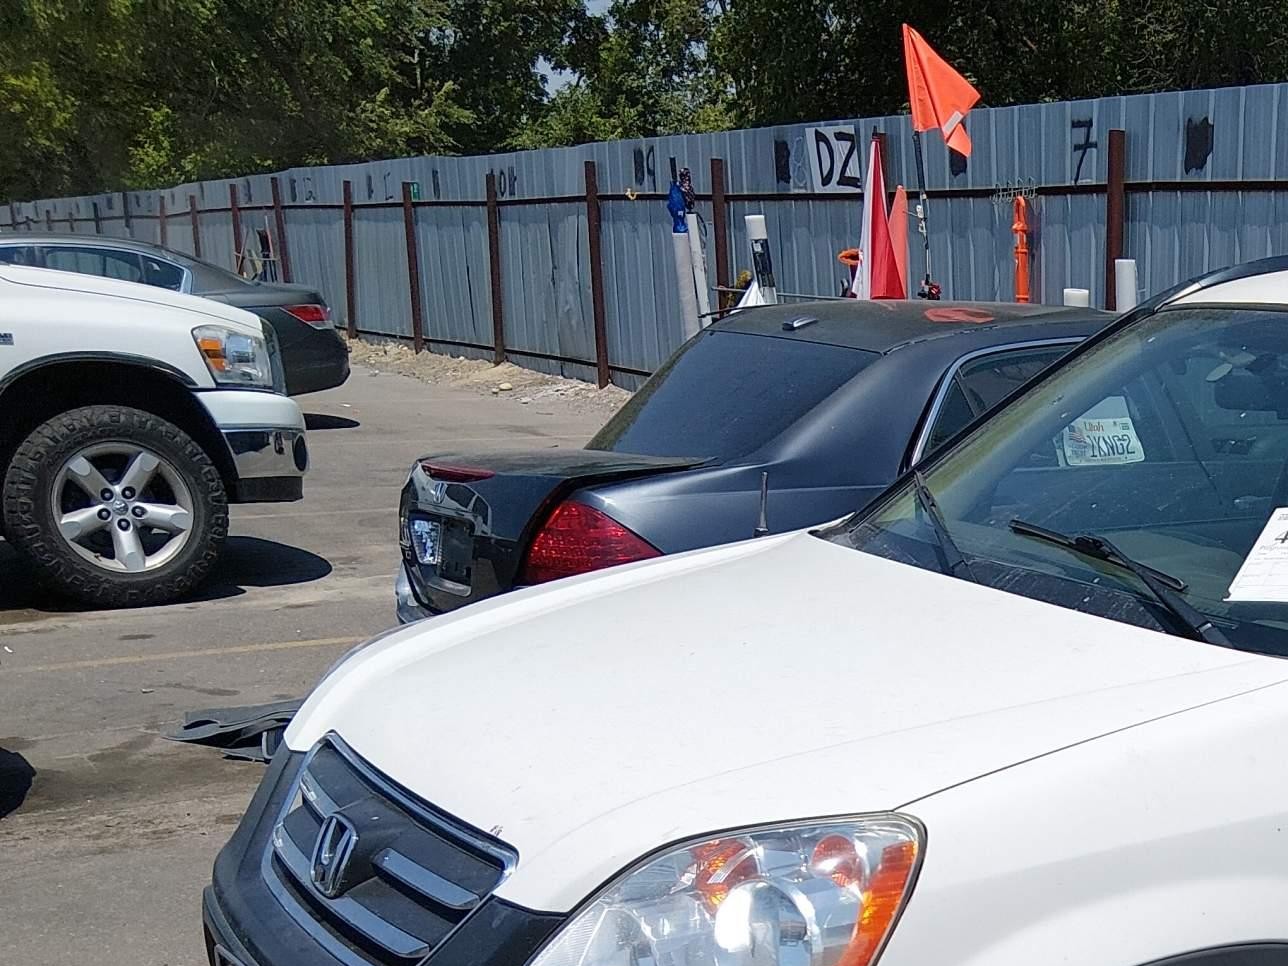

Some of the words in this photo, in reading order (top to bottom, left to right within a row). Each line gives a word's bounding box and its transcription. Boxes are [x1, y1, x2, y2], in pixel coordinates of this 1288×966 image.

[815, 128, 862, 188] DZ
[1071, 118, 1098, 184] 7
[1084, 421, 1104, 433] Utah
